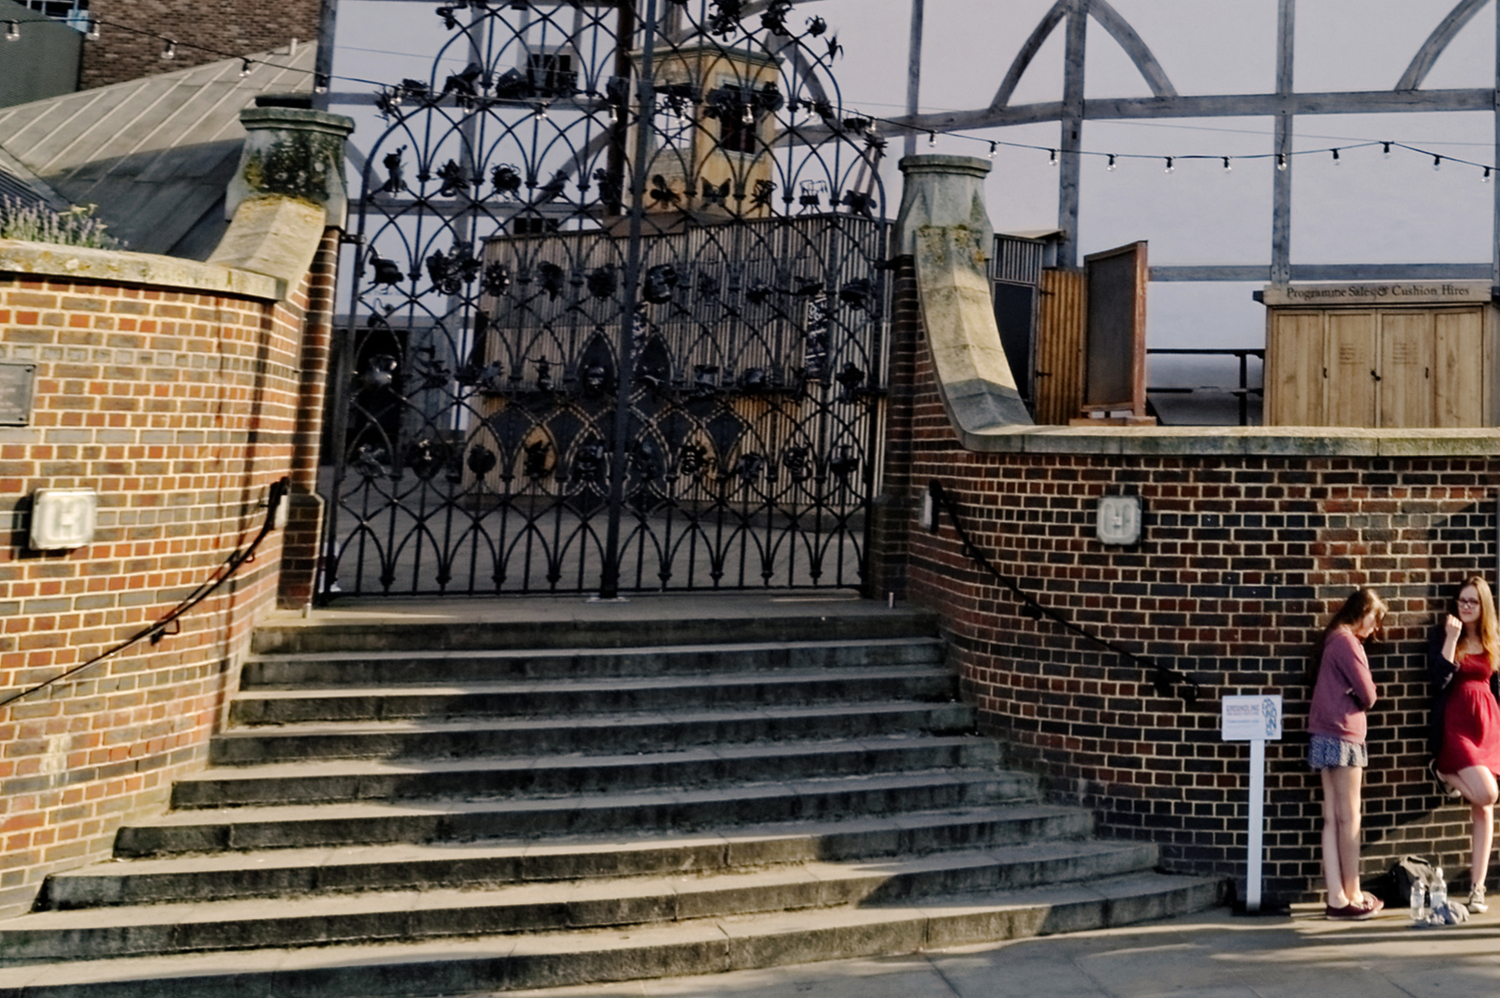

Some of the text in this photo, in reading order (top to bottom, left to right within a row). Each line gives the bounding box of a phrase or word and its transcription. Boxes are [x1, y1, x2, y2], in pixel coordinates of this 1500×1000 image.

[1287, 285, 1470, 300] Programme Sales & Cushion Hires
